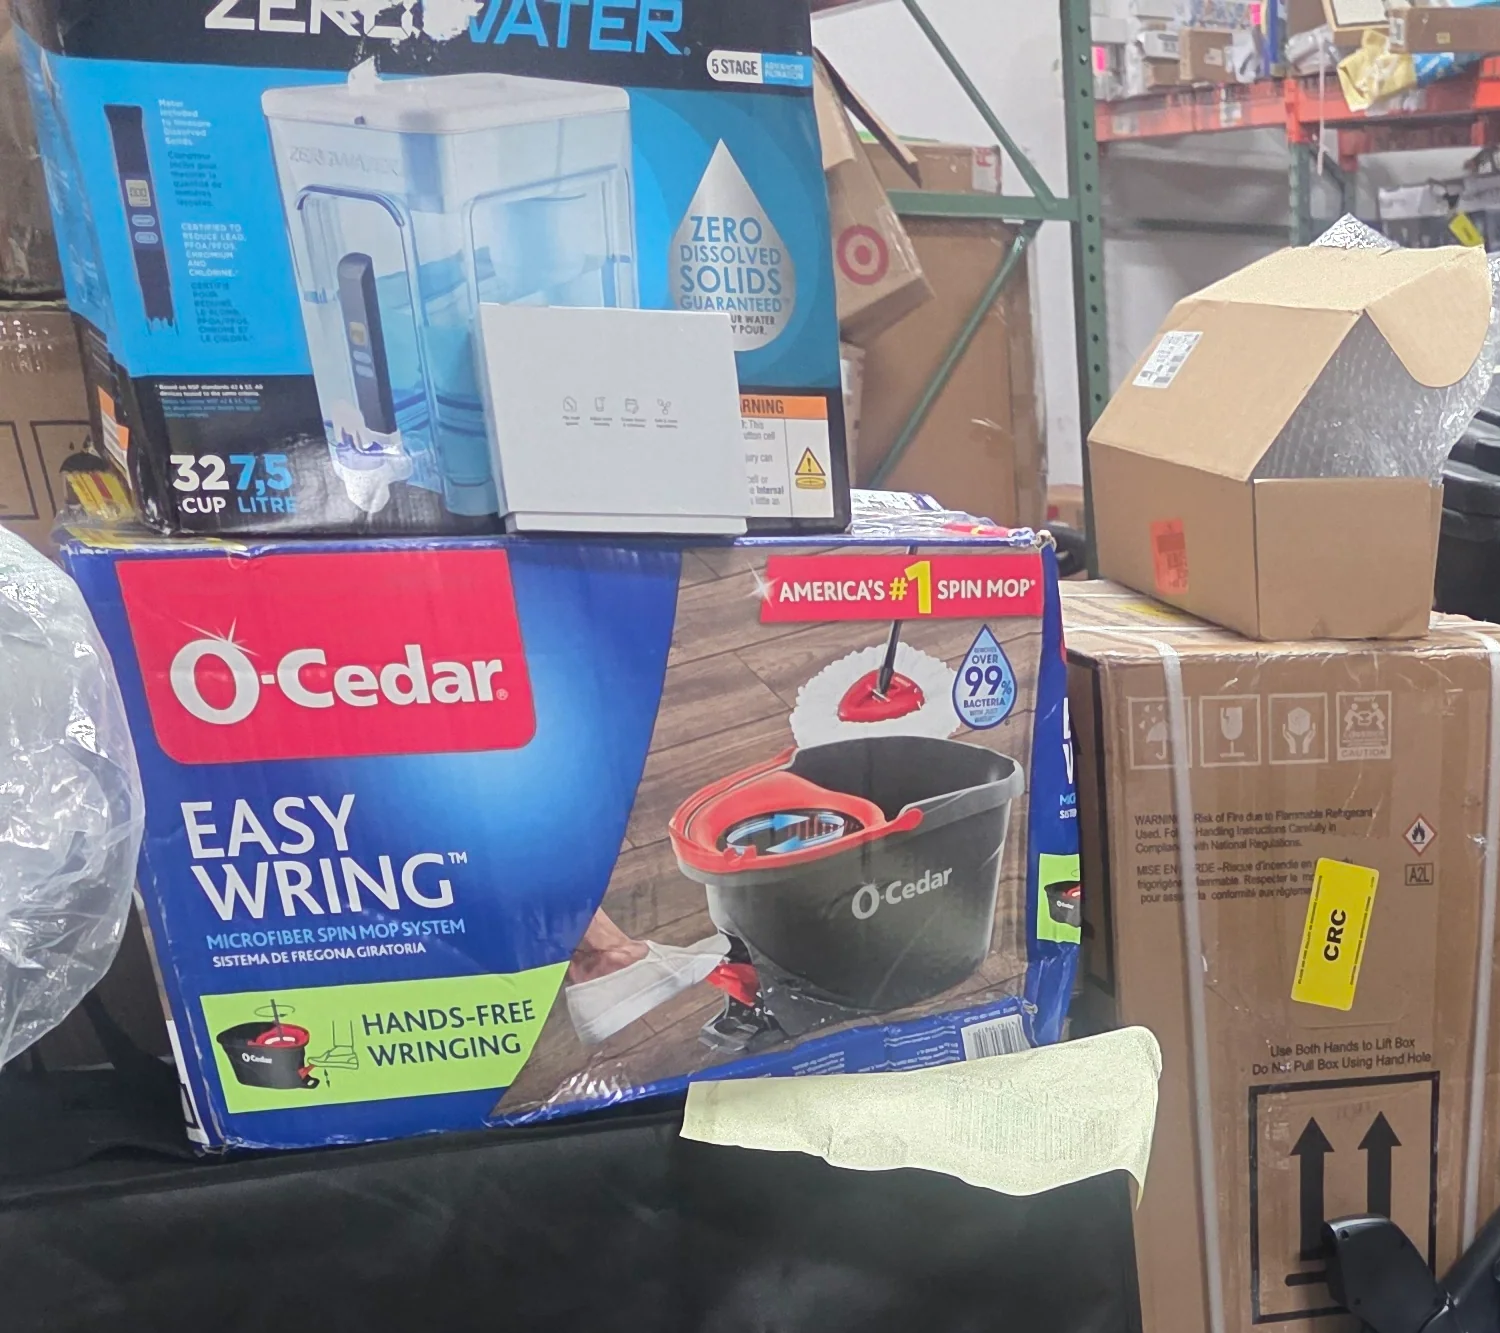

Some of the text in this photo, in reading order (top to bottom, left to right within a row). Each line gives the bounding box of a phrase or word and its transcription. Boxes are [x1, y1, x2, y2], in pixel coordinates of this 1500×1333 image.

[711, 58, 759, 76] 5 STAGE
[690, 215, 763, 245] ZERO
[680, 244, 782, 266] DISSOLVED
[680, 265, 783, 296] SOLIDS
[680, 294, 783, 313] GUARANTEED
[745, 315, 776, 326] WATER
[740, 398, 785, 415] RNING
[170, 453, 293, 496] 32 7,5
[181, 496, 298, 514] CUP LITRE
[779, 579, 886, 603] AMERICA'S
[889, 560, 932, 614] #1
[937, 580, 982, 600] SPIN
[971, 654, 999, 665] OVER
[169, 638, 504, 726] O-Cedar
[964, 665, 1013, 698] 99%
[963, 697, 1007, 709] BACTERIA
[180, 793, 356, 860] EASY
[1134, 813, 1179, 826] WARNIN
[1194, 813, 1214, 824] Risk
[1215, 812, 1226, 823] of
[1226, 811, 1244, 823] Fire
[1246, 811, 1263, 822] due
[1264, 810, 1274, 821] to
[1275, 809, 1324, 821] Flammable
[1195, 825, 1235, 838] Handling
[1236, 824, 1287, 836] Instructions
[1288, 822, 1326, 835] Carefully
[1328, 822, 1337, 832] in
[1135, 842, 1181, 855] Complian
[1211, 839, 1247, 851] National
[1249, 838, 1303, 850] Regulations.
[1136, 865, 1162, 876] MISE
[1301, 859, 1312, 869] en
[1408, 866, 1430, 883] A2L
[1243, 873, 1287, 886] Respecter
[851, 867, 953, 920] O-Cedar
[206, 918, 467, 950] MICROFIBER SPIN MOP SYSTEM
[1323, 908, 1347, 962] CRC
[212, 941, 427, 968] SISTEMA DE FREGONA GIRATORIA
[361, 999, 536, 1036] HANDS-FREE
[367, 1033, 521, 1067] WRINGING
[1270, 1037, 1415, 1058] Use Both Hands to Lift Box
[1252, 1063, 1269, 1076] Do
[1293, 1060, 1314, 1073] Pull
[1317, 1058, 1339, 1071] Box
[1341, 1056, 1373, 1070] Using
[1375, 1053, 1405, 1066] Hand
[1407, 1051, 1432, 1064] Hole
